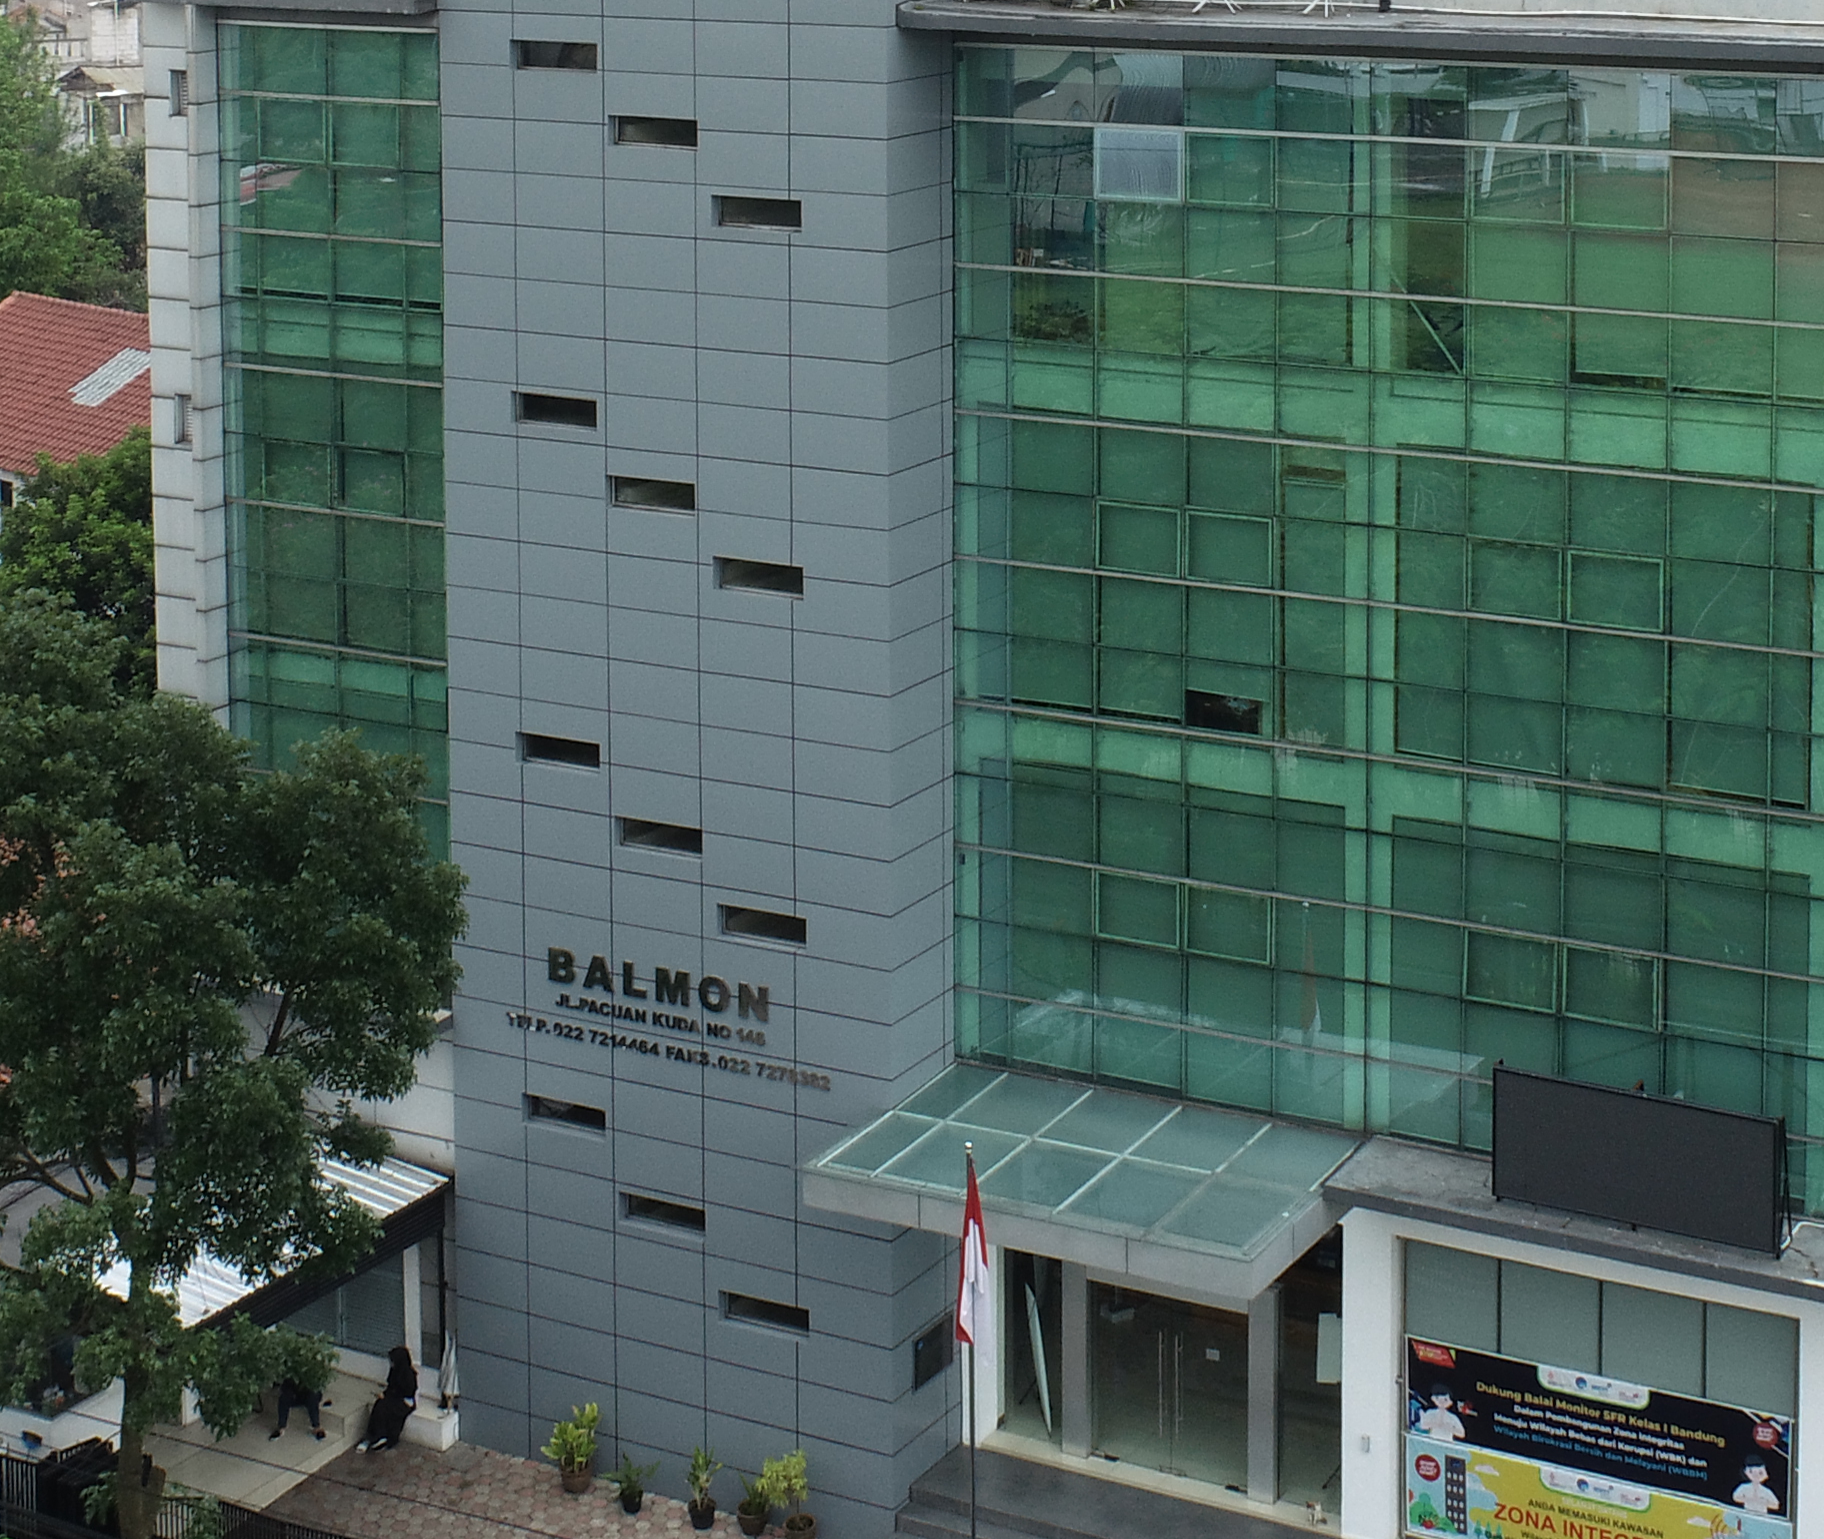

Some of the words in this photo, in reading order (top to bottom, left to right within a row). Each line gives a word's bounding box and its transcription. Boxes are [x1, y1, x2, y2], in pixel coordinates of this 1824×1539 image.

[548, 947, 770, 1022] BALMON
[589, 1028, 661, 1057] 7214464
[652, 1012, 701, 1034] KUDA
[706, 1022, 732, 1040] NO
[1476, 1381, 1521, 1402] Dukung
[1524, 1392, 1554, 1407] Balai
[1555, 1399, 1600, 1418] Monitor
[1603, 1410, 1626, 1423] SFR
[1628, 1415, 1661, 1431] Kelas
[1670, 1425, 1725, 1448] Bandung
[1514, 1405, 1544, 1419] Dalam
[1545, 1412, 1612, 1434] Pembangunan
[1613, 1426, 1637, 1440] Zona
[1639, 1432, 1685, 1450] Integritas
[1494, 1413, 1528, 1430] Menuju
[1529, 1421, 1567, 1438] Wilayah
[1568, 1429, 1596, 1445] Bebas
[1597, 1436, 1616, 1449] dari
[1618, 1440, 1654, 1458] Korupsi
[1655, 1450, 1687, 1465] (WBK)
[1688, 1455, 1708, 1468] dan
[1494, 1425, 1530, 1442] Wilayah
[1531, 1433, 1573, 1450] Birokrasi
[1574, 1443, 1603, 1458] Bersih
[1605, 1450, 1623, 1462] dan
[1625, 1456, 1667, 1473] Melayani
[1494, 1502, 1556, 1533] ZONA
[1528, 1498, 1556, 1512] ANDA
[1557, 1506, 1611, 1526] MEMASUKI
[1613, 1520, 1664, 1539] KAWASAN
